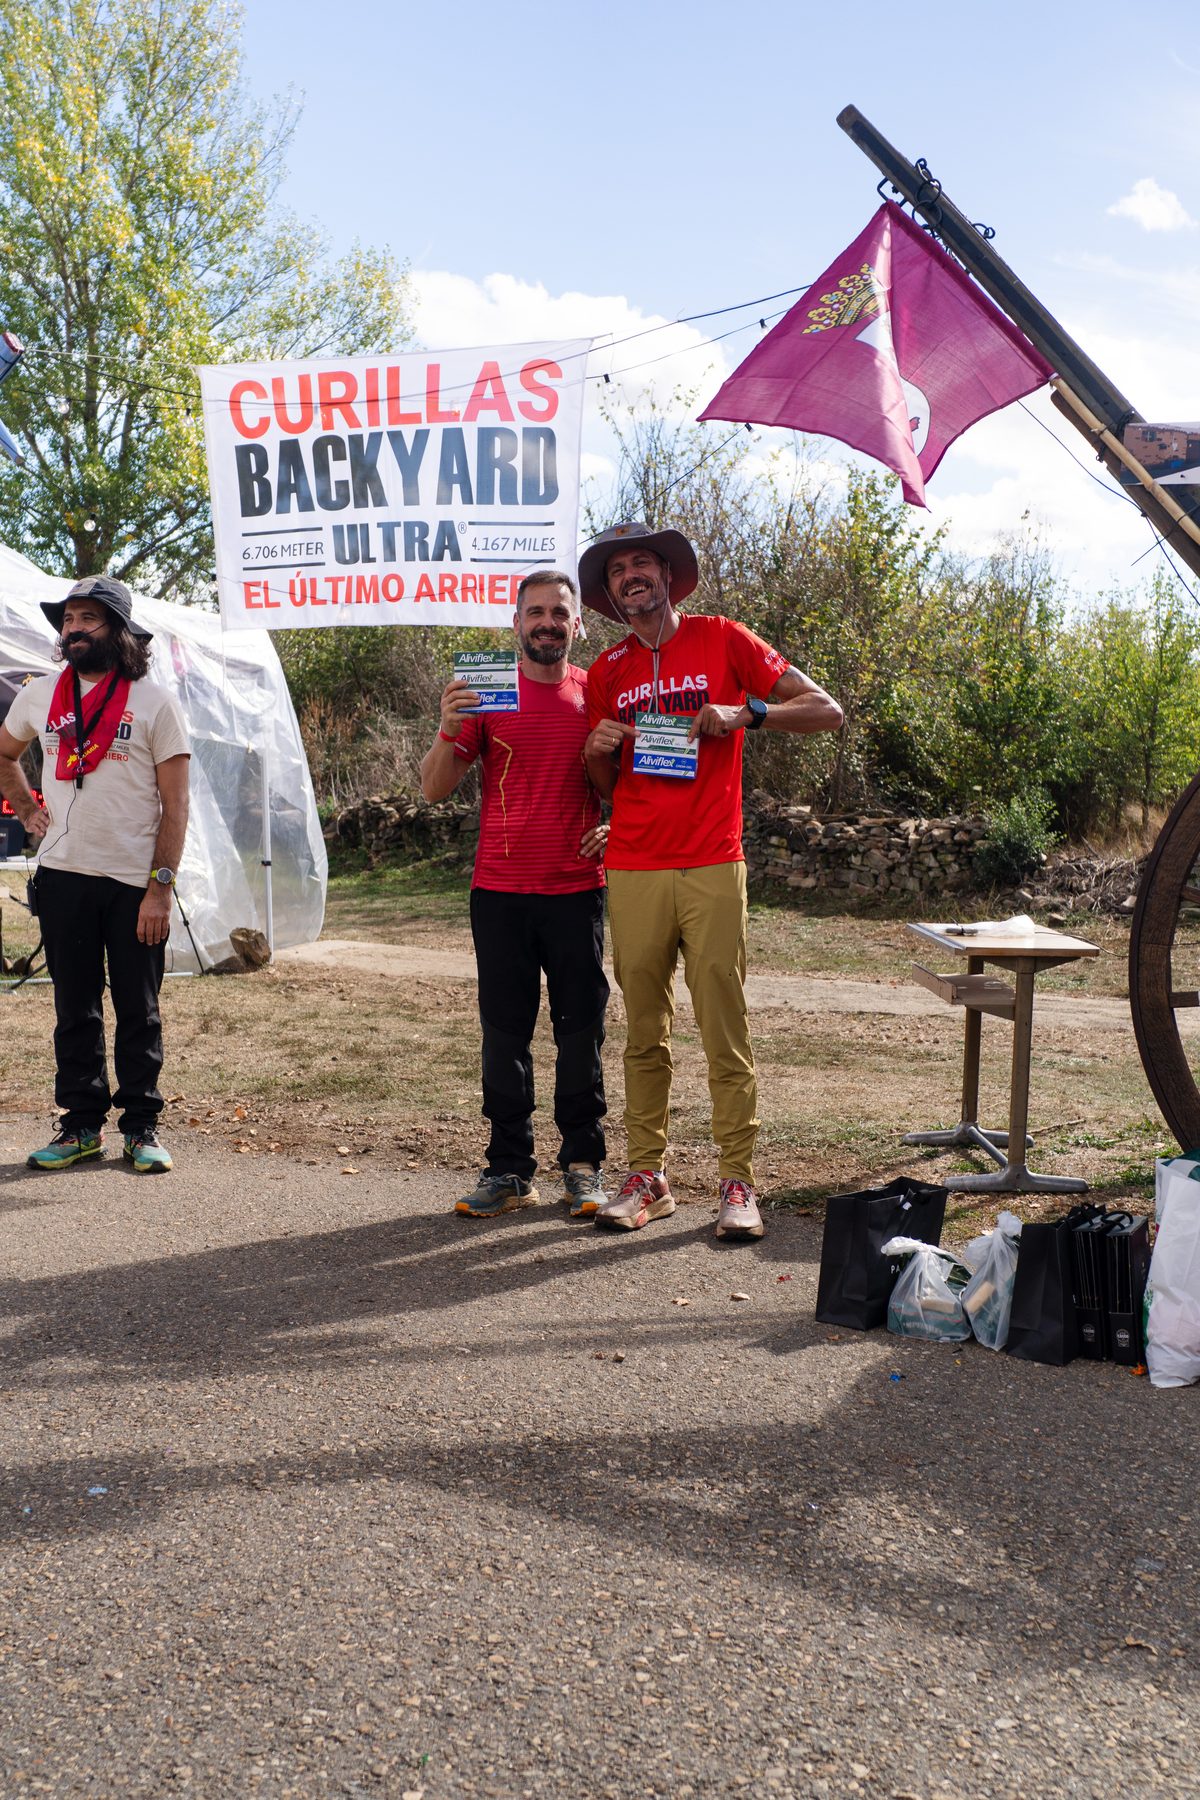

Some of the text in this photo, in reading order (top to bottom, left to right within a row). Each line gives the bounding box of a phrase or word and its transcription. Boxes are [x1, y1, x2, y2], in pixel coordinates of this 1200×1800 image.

[228, 358, 563, 440] CURILLAS
[234, 426, 560, 518] BACKYARD
[242, 541, 324, 560] 6.706 METER
[471, 536, 556, 552] 4.167 MILES
[243, 579, 281, 609] EL
[289, 570, 405, 607] ÚLTIMO
[617, 674, 708, 708] CURILLAS
